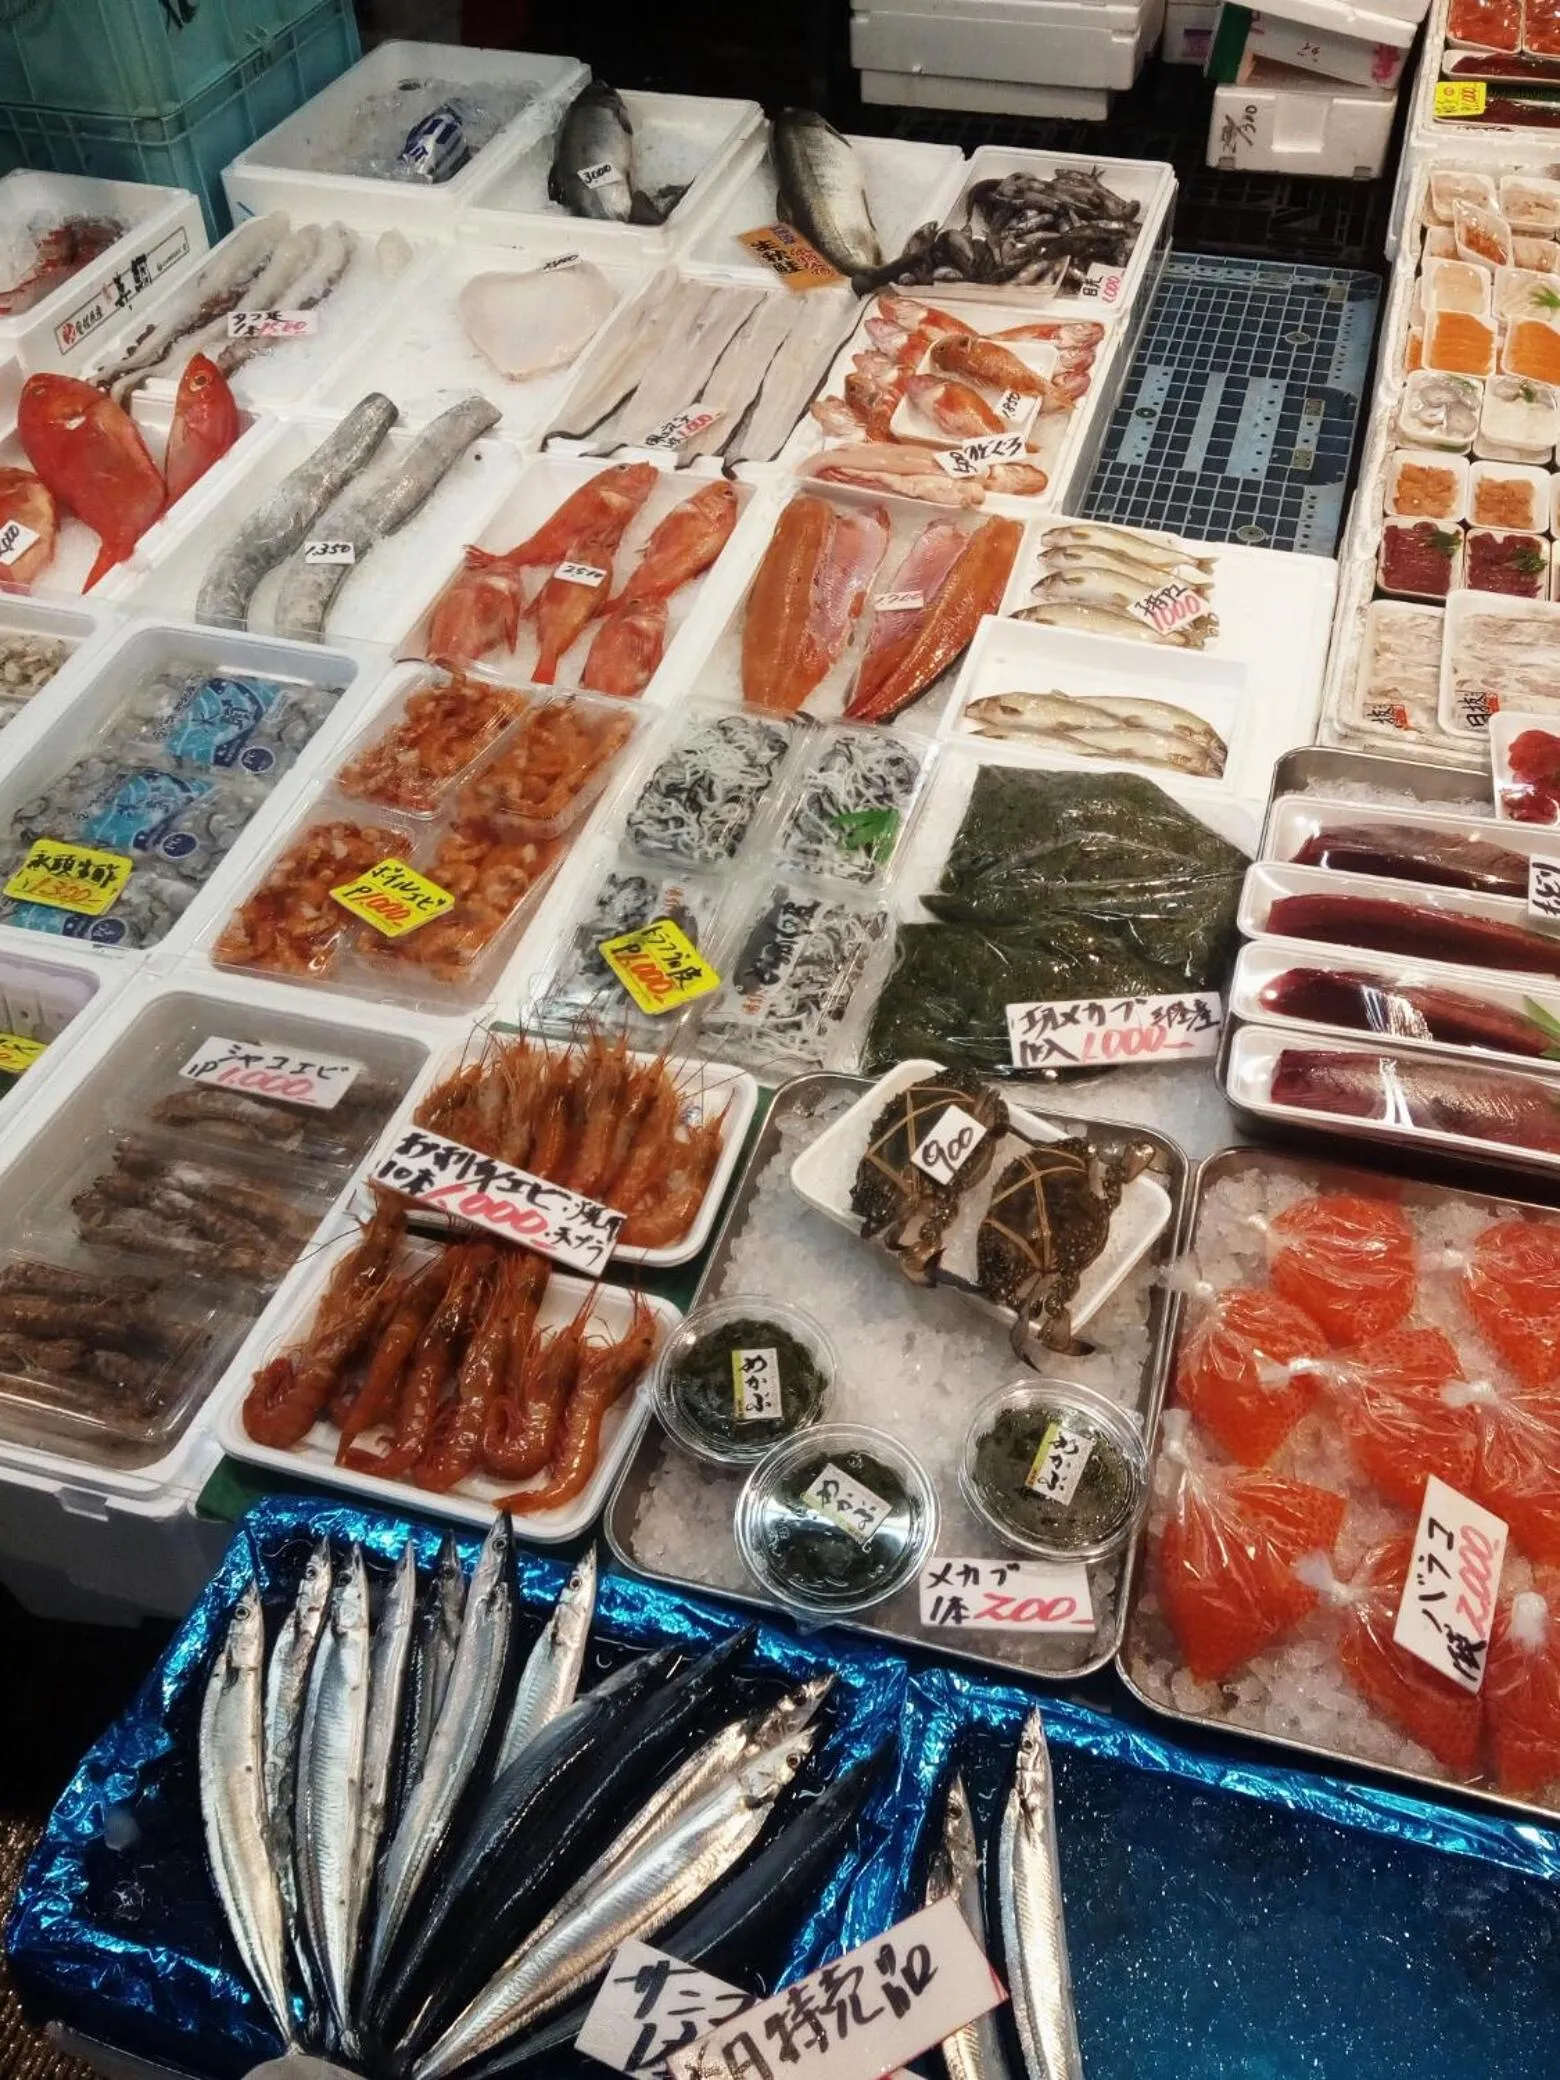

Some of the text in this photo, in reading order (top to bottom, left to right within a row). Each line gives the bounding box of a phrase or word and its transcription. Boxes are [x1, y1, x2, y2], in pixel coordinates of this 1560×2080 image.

[218, 1044, 349, 1079] シャコエビ
[922, 1127, 974, 1173] 900
[738, 1354, 772, 1413] めかぶ
[1036, 1432, 1080, 1491] めかぶ
[815, 1479, 877, 1530] めかぶ
[926, 1562, 1021, 1589] メカブ
[1417, 1516, 1454, 1634] バラコ
